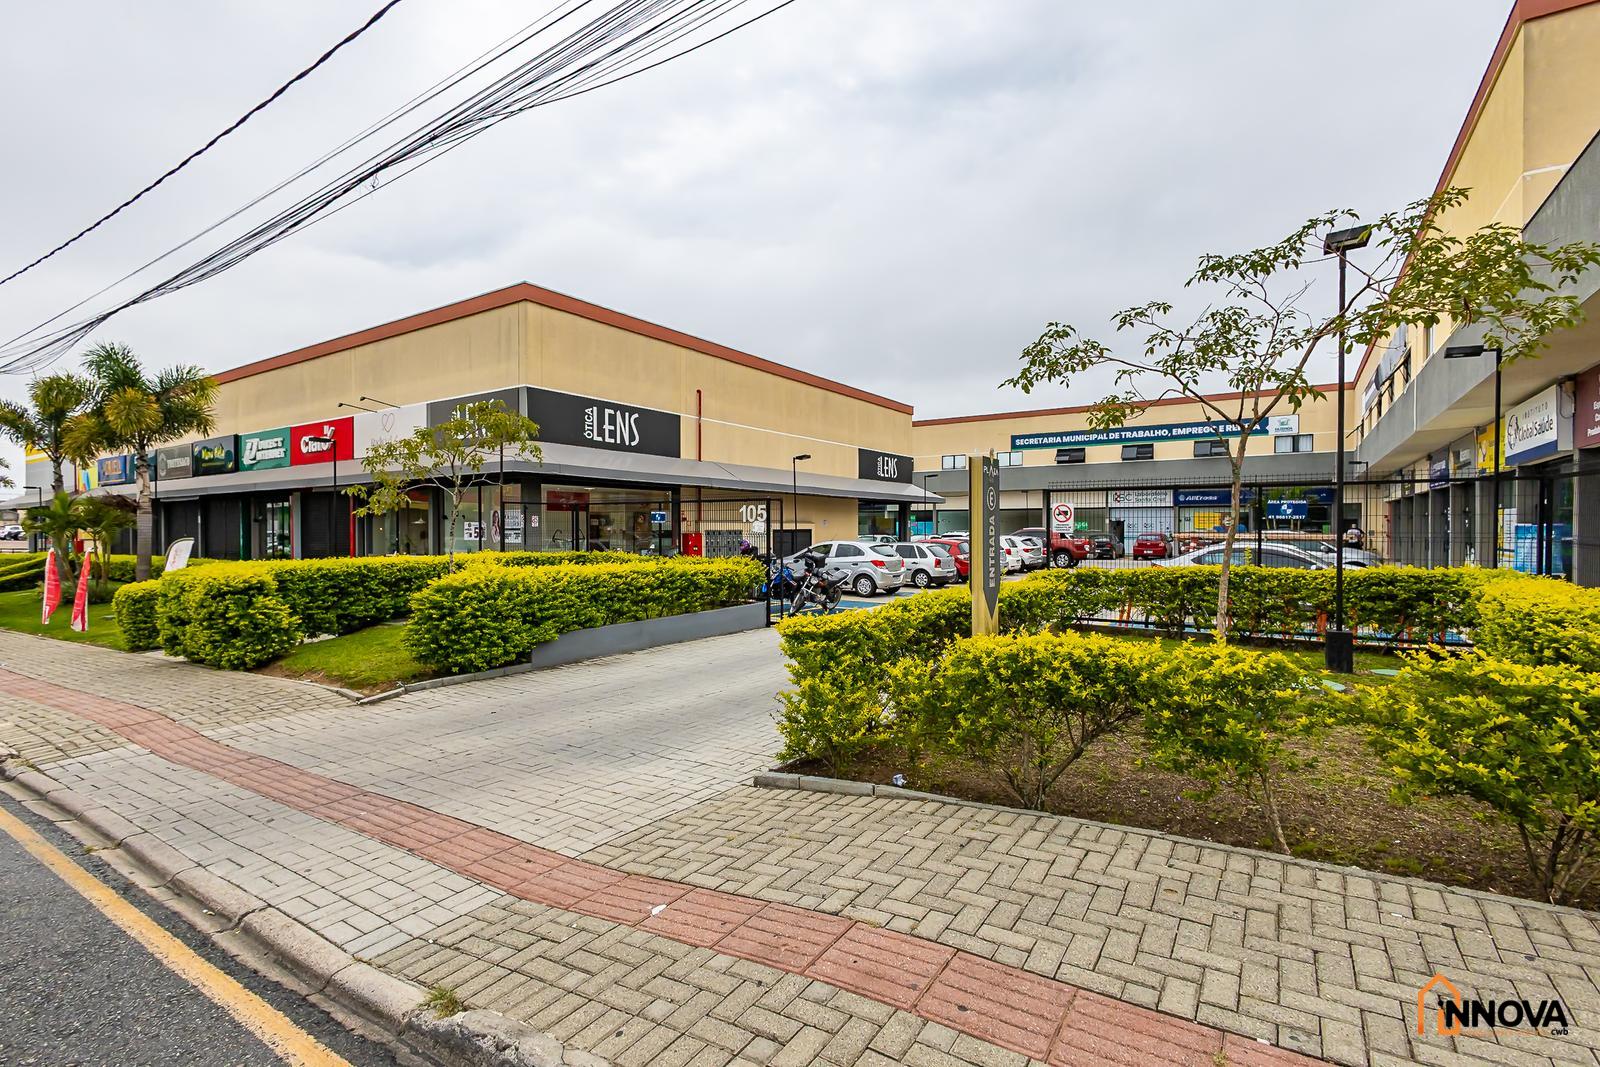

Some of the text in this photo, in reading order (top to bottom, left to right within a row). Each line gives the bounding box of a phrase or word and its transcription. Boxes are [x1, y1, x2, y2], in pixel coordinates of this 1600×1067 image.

[1523, 401, 1548, 419] INSTITUTO
[584, 407, 639, 446] ÓTICA LENS
[1015, 436, 1062, 446] SECRETARIA
[1062, 433, 1108, 443] MUNICIPAL
[1120, 429, 1171, 438] TRABALHO,
[1172, 425, 1216, 436] EMPREGO
[1219, 424, 1225, 432] E
[1226, 423, 1261, 432] REA
[880, 456, 898, 478] LENS
[739, 504, 767, 523] 105
[988, 515, 996, 588] ENTRADA
